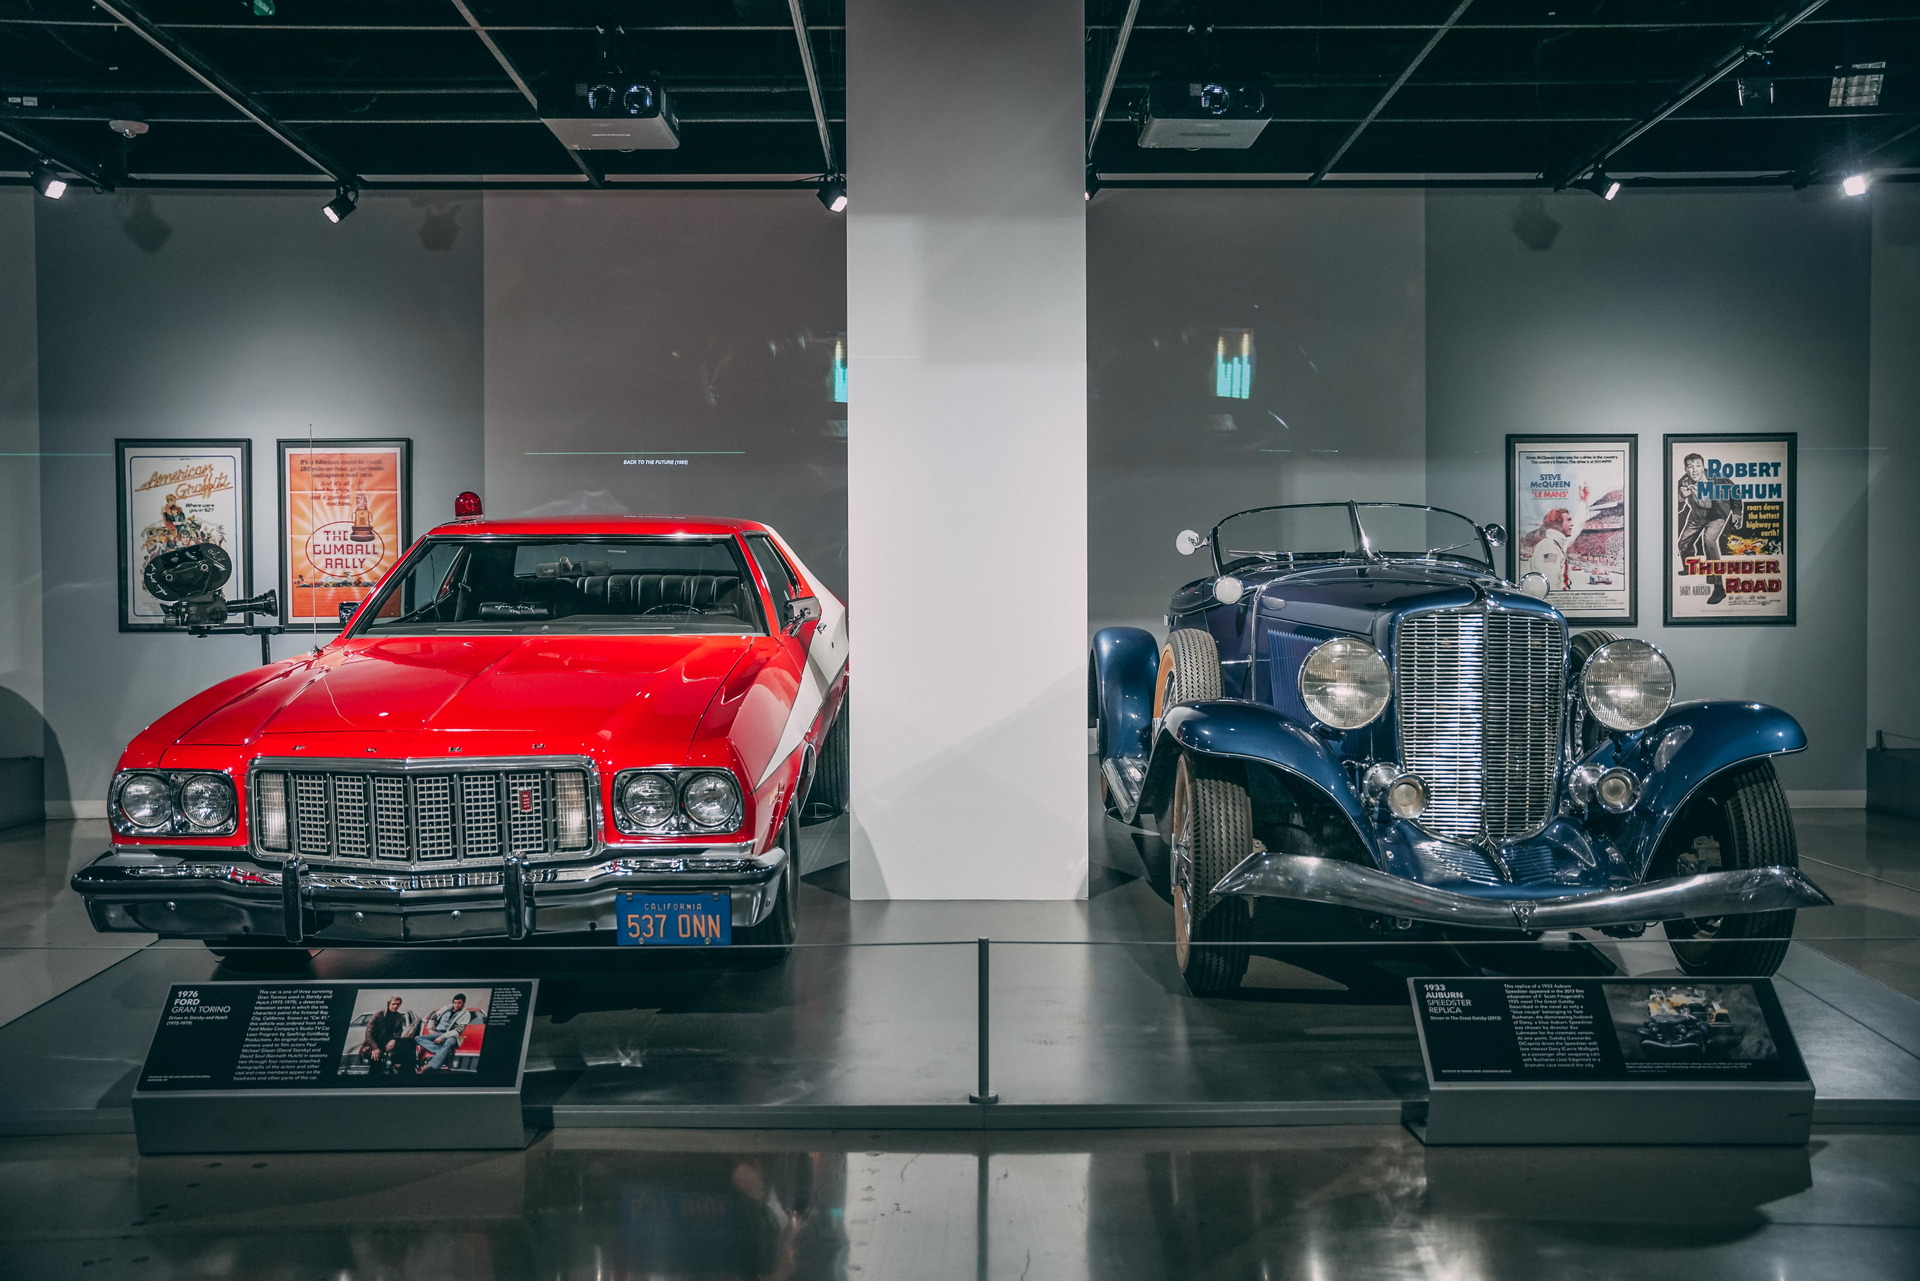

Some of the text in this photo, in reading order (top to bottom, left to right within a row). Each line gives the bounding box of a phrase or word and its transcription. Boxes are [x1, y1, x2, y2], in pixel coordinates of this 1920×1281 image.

[140, 464, 214, 490] American
[1708, 459, 1781, 478] ROBERT
[175, 472, 230, 499] Graffiti
[1698, 481, 1781, 500] MITCHUM
[1746, 521, 1771, 529] highway
[324, 531, 348, 541] THE
[313, 544, 378, 555] GUMBALL
[326, 558, 366, 568] RALLY
[1686, 557, 1780, 575] THUNDER
[1726, 577, 1781, 593] ROAD
[628, 914, 667, 938] 537
